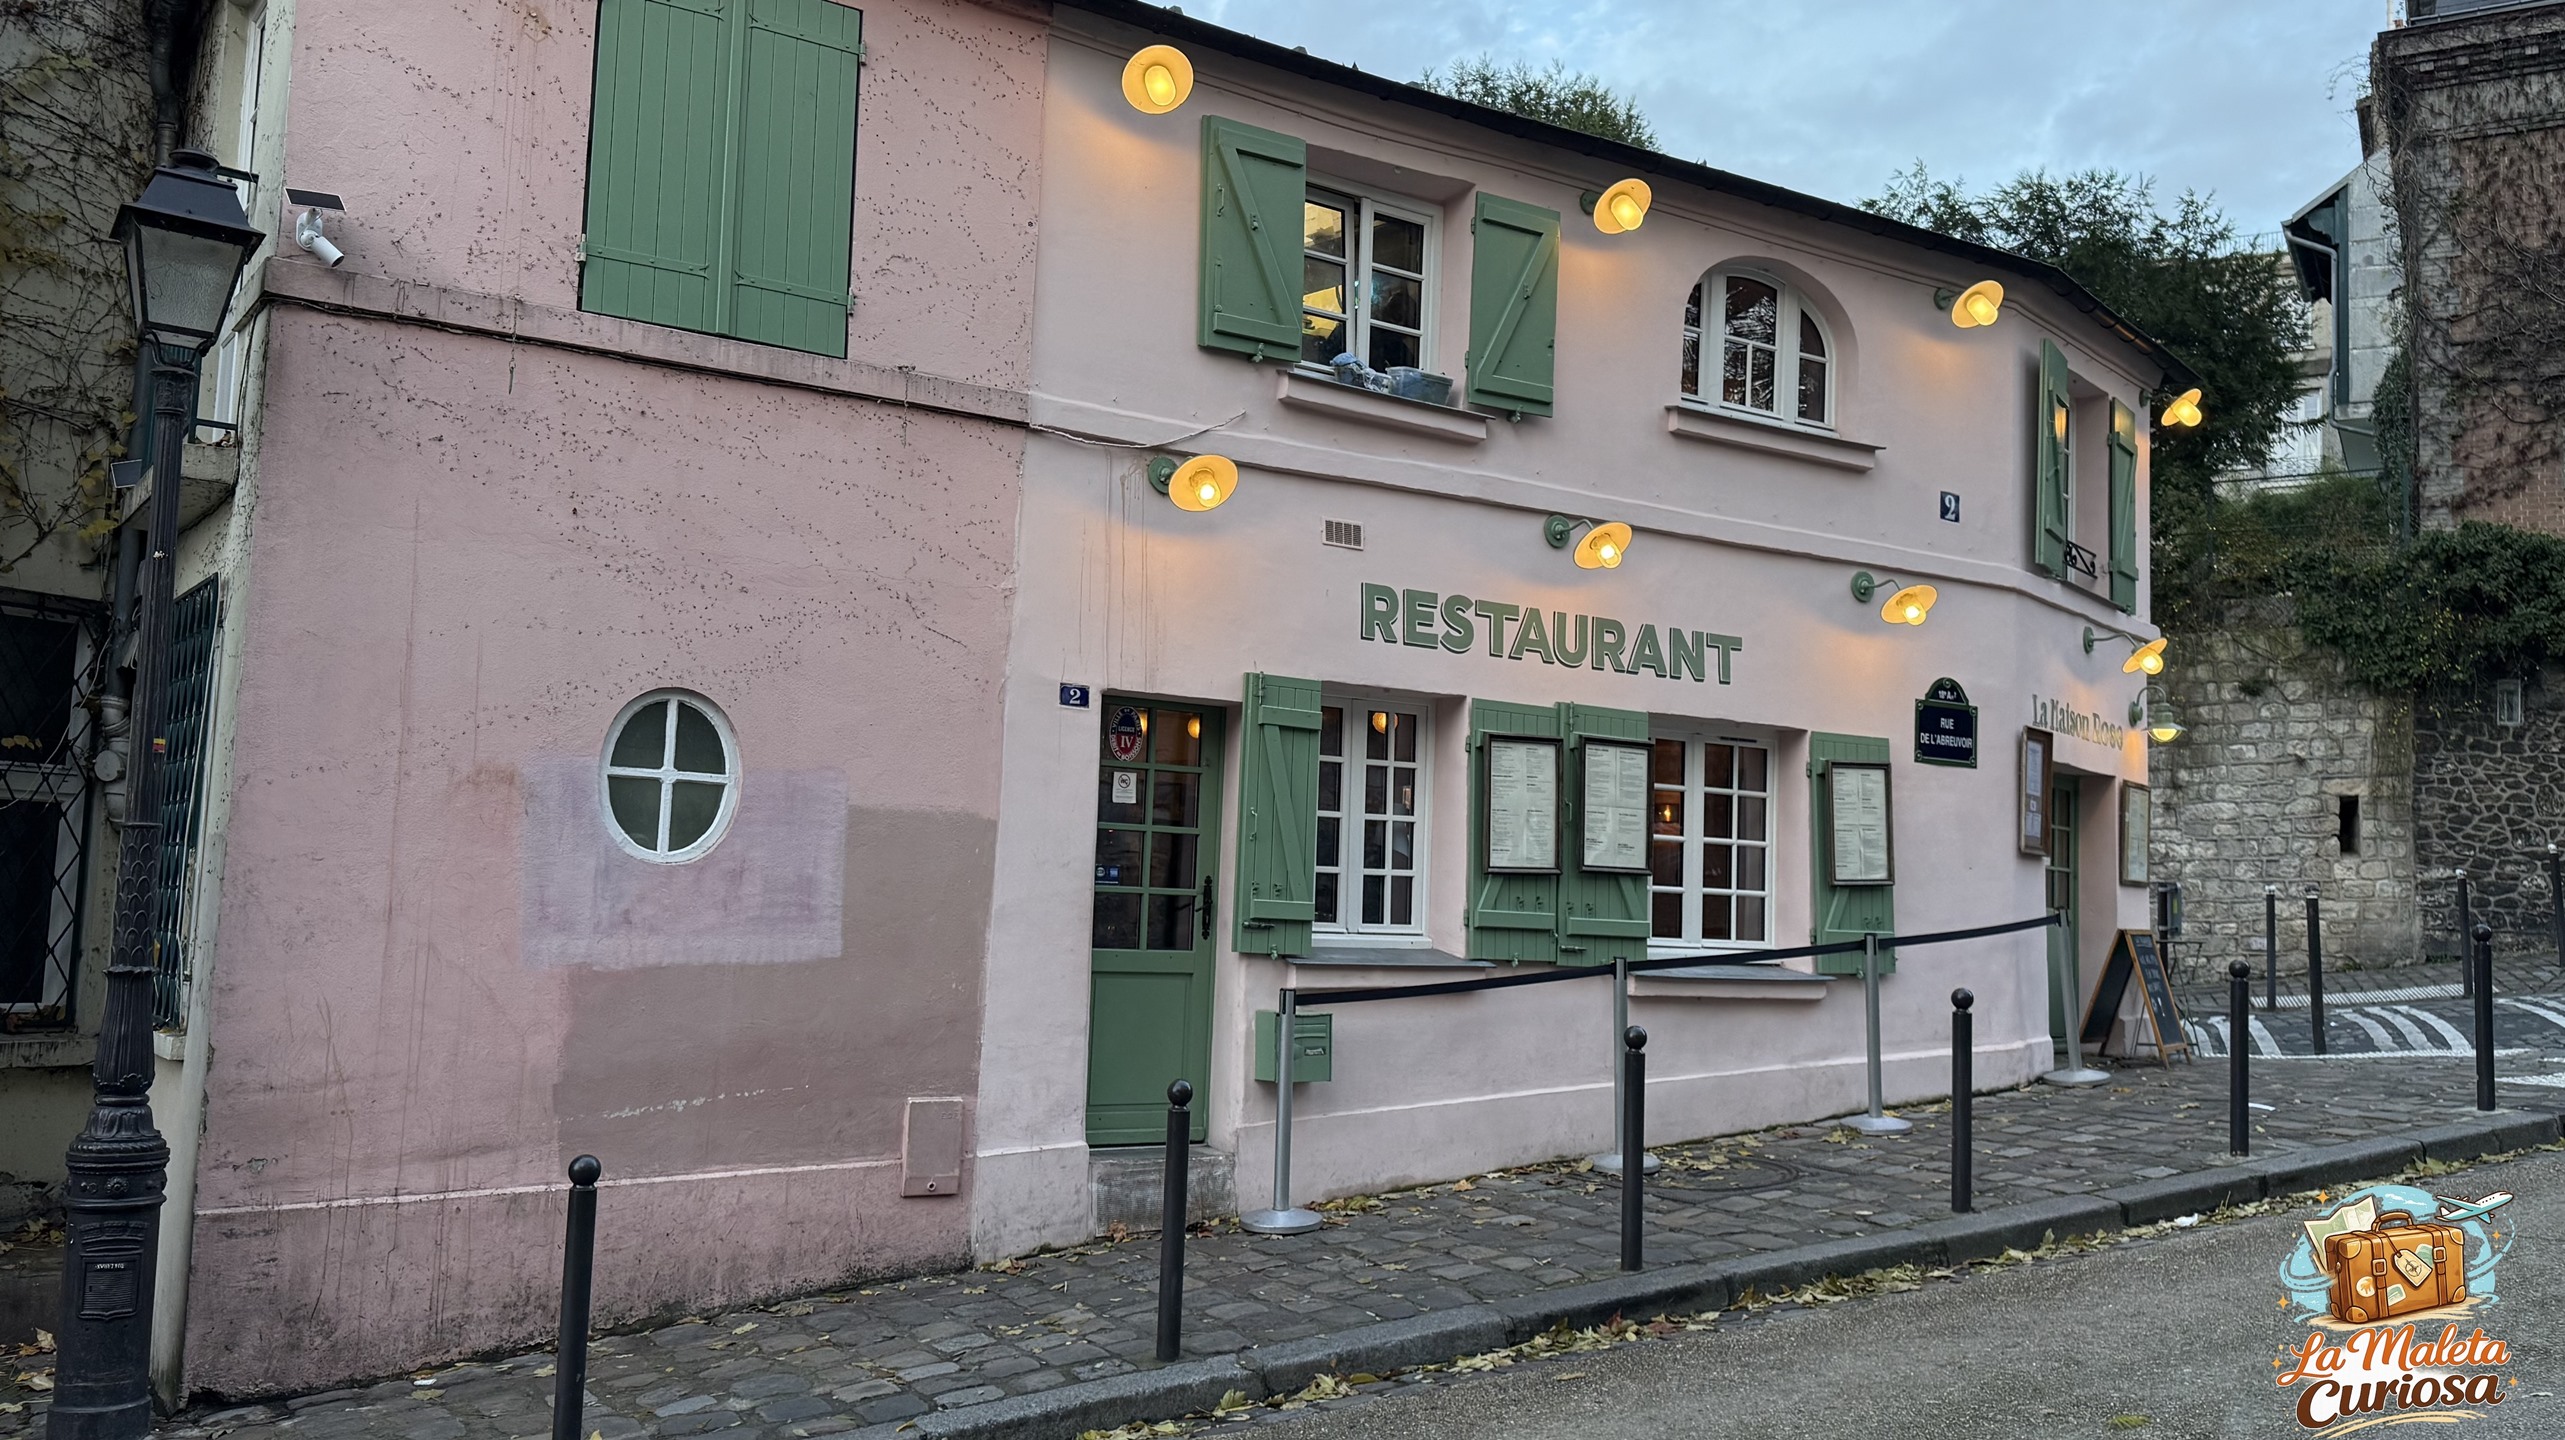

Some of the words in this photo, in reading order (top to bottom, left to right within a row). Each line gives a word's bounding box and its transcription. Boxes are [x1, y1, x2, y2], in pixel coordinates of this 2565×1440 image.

[1945, 495, 1956, 520] 2
[1360, 581, 1743, 685] RESTAURANT
[1069, 688, 1081, 704] 2
[1940, 717, 1955, 730] RUE
[2032, 694, 2048, 728] La
[2050, 698, 2090, 741] Maison
[2092, 712, 2124, 751] Rose
[1120, 735, 1134, 748] IV
[1920, 732, 1930, 744] DE
[1930, 733, 1973, 749] L'ABREUVOIR
